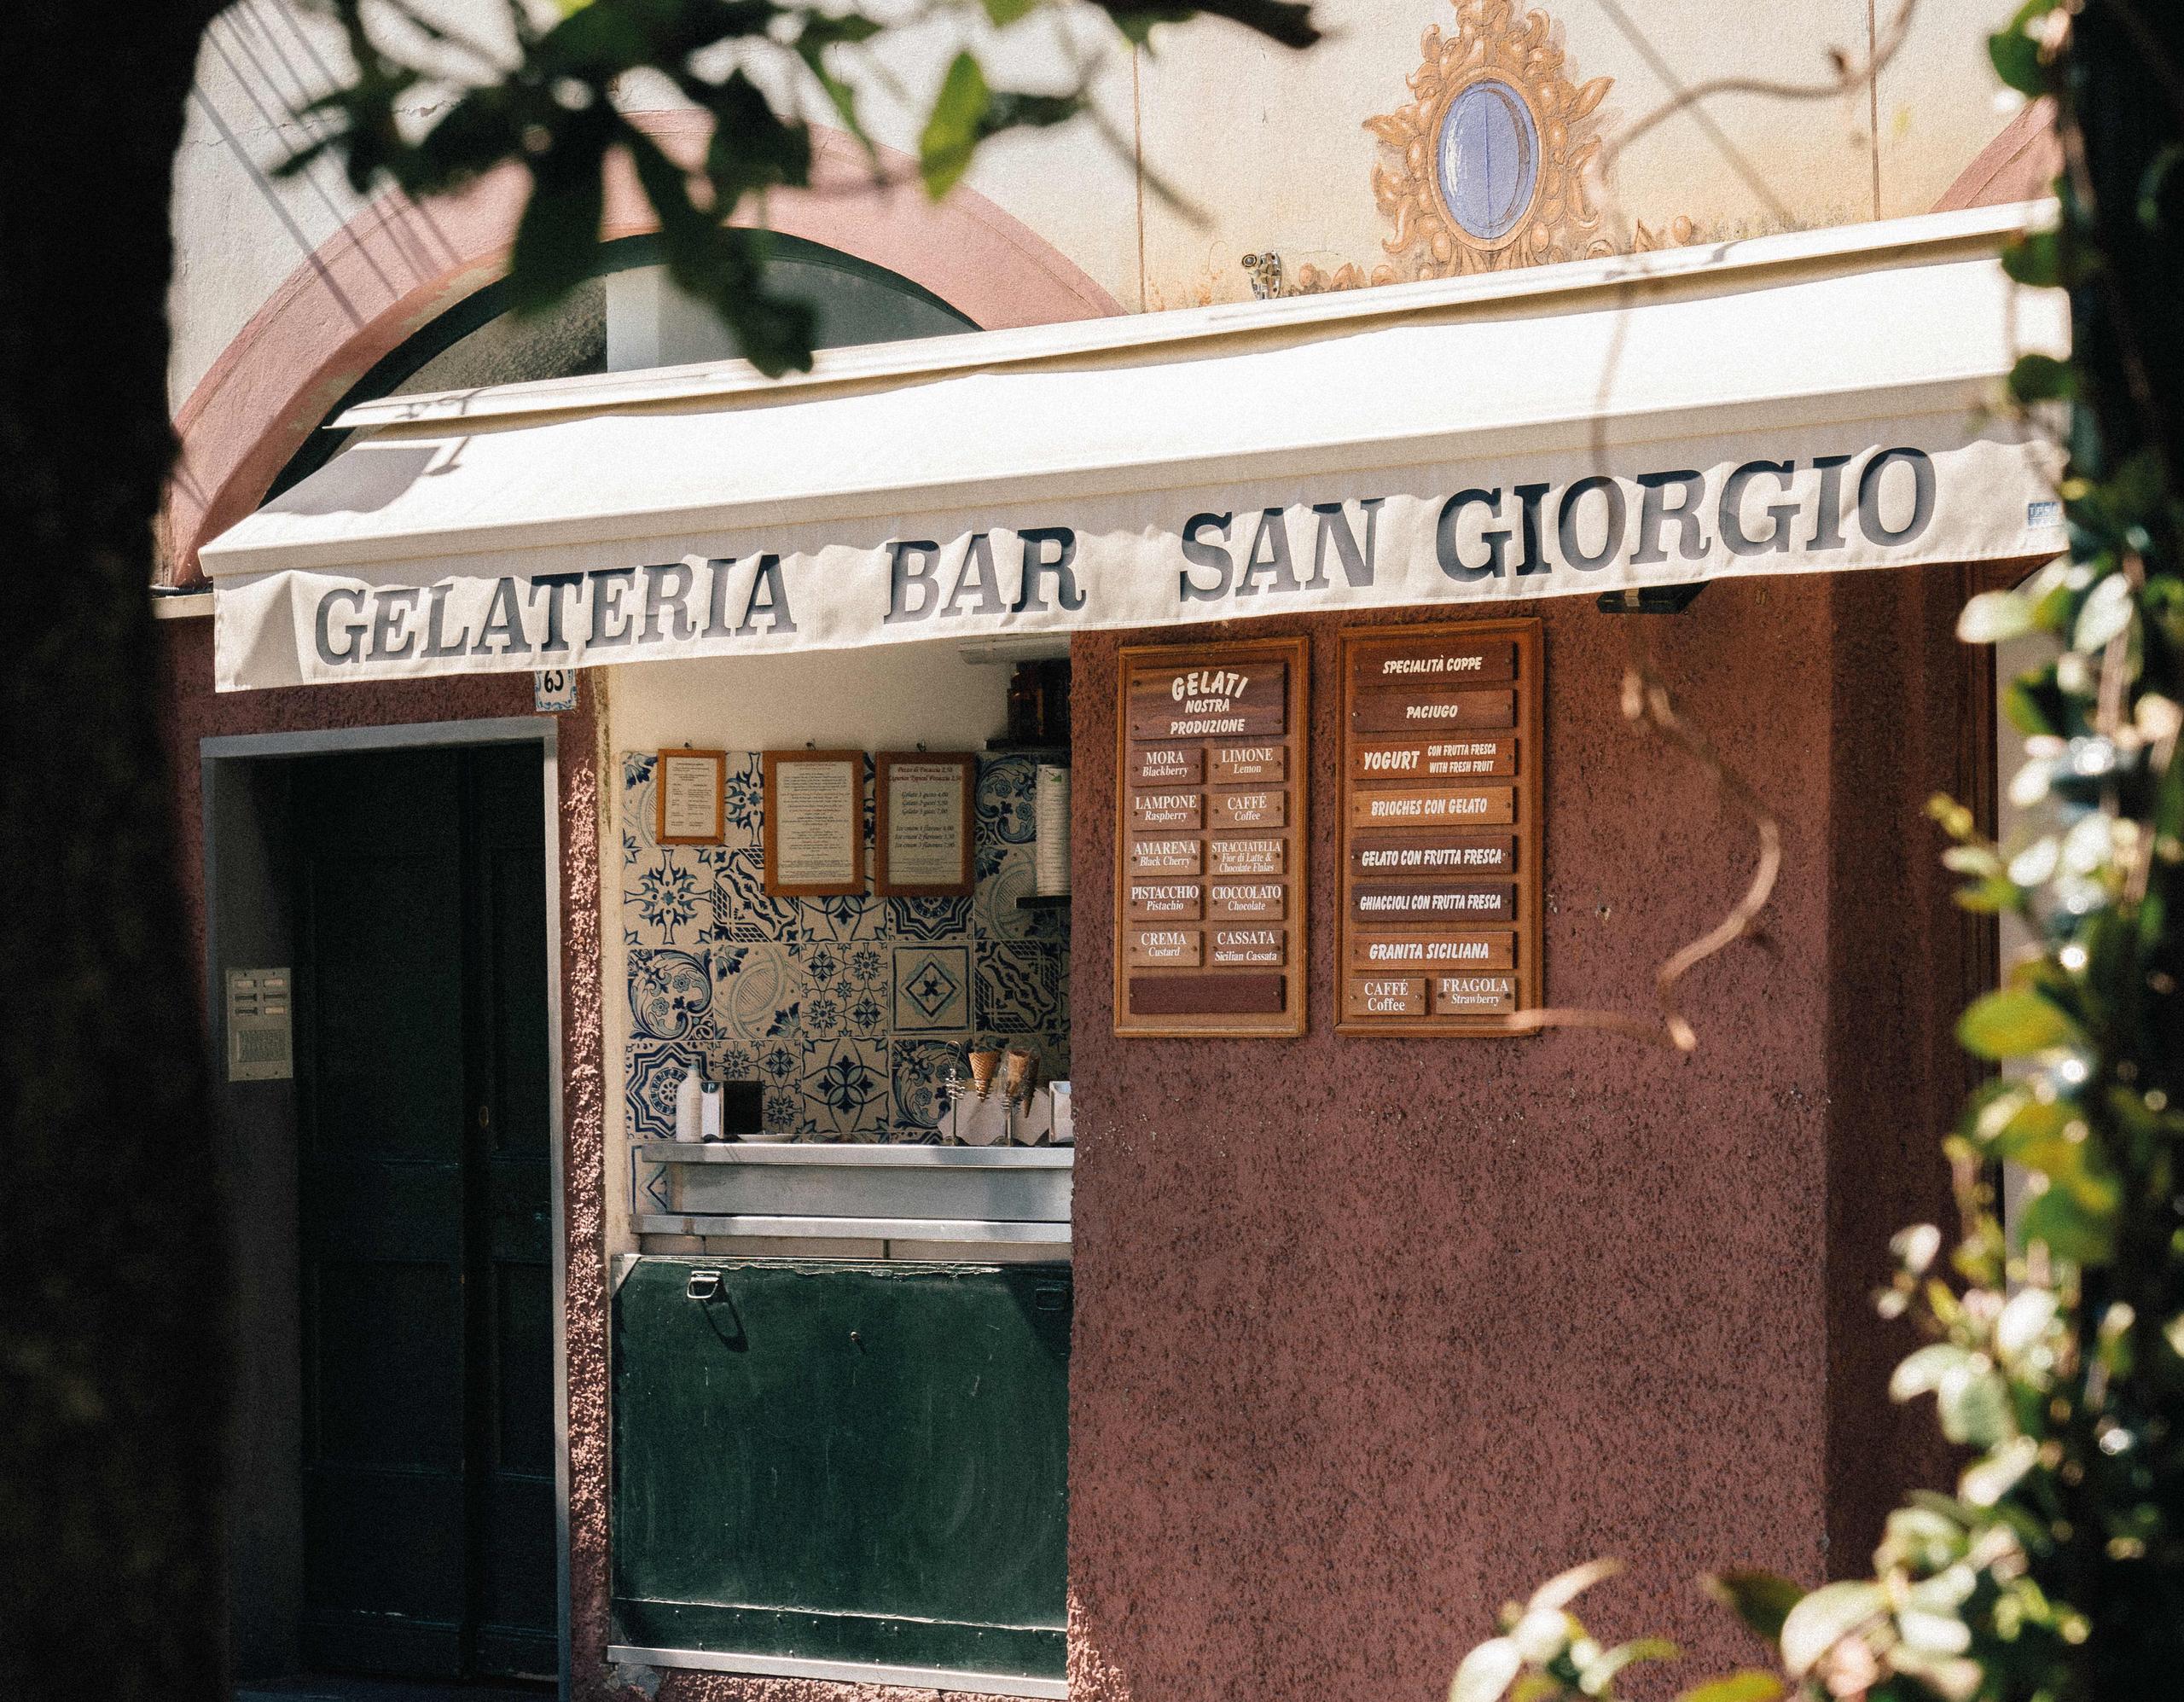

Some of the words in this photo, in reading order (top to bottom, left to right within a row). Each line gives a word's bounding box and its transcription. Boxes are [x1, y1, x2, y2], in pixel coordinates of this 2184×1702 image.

[315, 553, 798, 666] GELATERIA
[883, 526, 1087, 624] BAR
[1179, 498, 1386, 602] SAN
[1435, 446, 1937, 584] GIORGIO
[1383, 655, 1443, 674] SPECIALITÀ
[1446, 657, 1482, 671] COPPE
[1172, 671, 1248, 701] GELATI
[1185, 699, 1229, 713] NOSTRA
[1407, 706, 1458, 719] PACIUGO
[1170, 719, 1246, 735] PRODUZIONE
[1222, 748, 1273, 763] LIMONE
[1427, 746, 1442, 756] CON
[1443, 744, 1469, 756] FRUTTA
[1471, 743, 1496, 755] FRESCA
[1147, 751, 1184, 765] MORA
[1364, 751, 1420, 770] YOGURT
[1142, 765, 1188, 777] Blackberry
[1234, 764, 1261, 774] Lemon
[1430, 762, 1447, 773] WITH
[1449, 761, 1471, 773] FRESH
[1473, 761, 1494, 772] FRUIT
[1136, 795, 1197, 810] LAMPONE
[1372, 800, 1421, 816] BRIOCHES
[1425, 800, 1446, 815] CON
[1449, 799, 1487, 813] GELATO
[1145, 810, 1188, 822] Raspberry
[1234, 810, 1261, 822] Coffee
[1134, 841, 1196, 856] AMARENA
[1211, 841, 1281, 852] STRACCIATELLA
[1140, 856, 1160, 867] Black
[1163, 856, 1190, 868] Cherry
[1362, 851, 1398, 866] GELATO
[1401, 851, 1420, 865] CON
[1423, 849, 1461, 865] FRUTTA
[1464, 849, 1502, 865] FRESCA
[1131, 886, 1199, 899] PISTACCHIO
[1211, 886, 1281, 899] CIOCCOLATO
[1147, 900, 1184, 911] Pistachio
[1228, 902, 1265, 911] Chocolate
[1361, 896, 1409, 910] GHIACCIOLI
[1411, 896, 1430, 909] CON
[1432, 895, 1465, 909] FRUTTA
[1467, 895, 1501, 909] FRESCA
[1141, 932, 1187, 945] CREMA
[1217, 932, 1275, 944] CASSATA
[1148, 946, 1180, 957] Custard
[1215, 951, 1243, 961] Sicilian
[1246, 951, 1276, 961] Cassata
[1369, 944, 1423, 960] GRANITA
[1426, 944, 1488, 959] SICILIANA
[1443, 979, 1508, 993] FRAGOLA
[1368, 998, 1405, 1011] Coffee
[1451, 994, 1501, 1006] Strawberry
